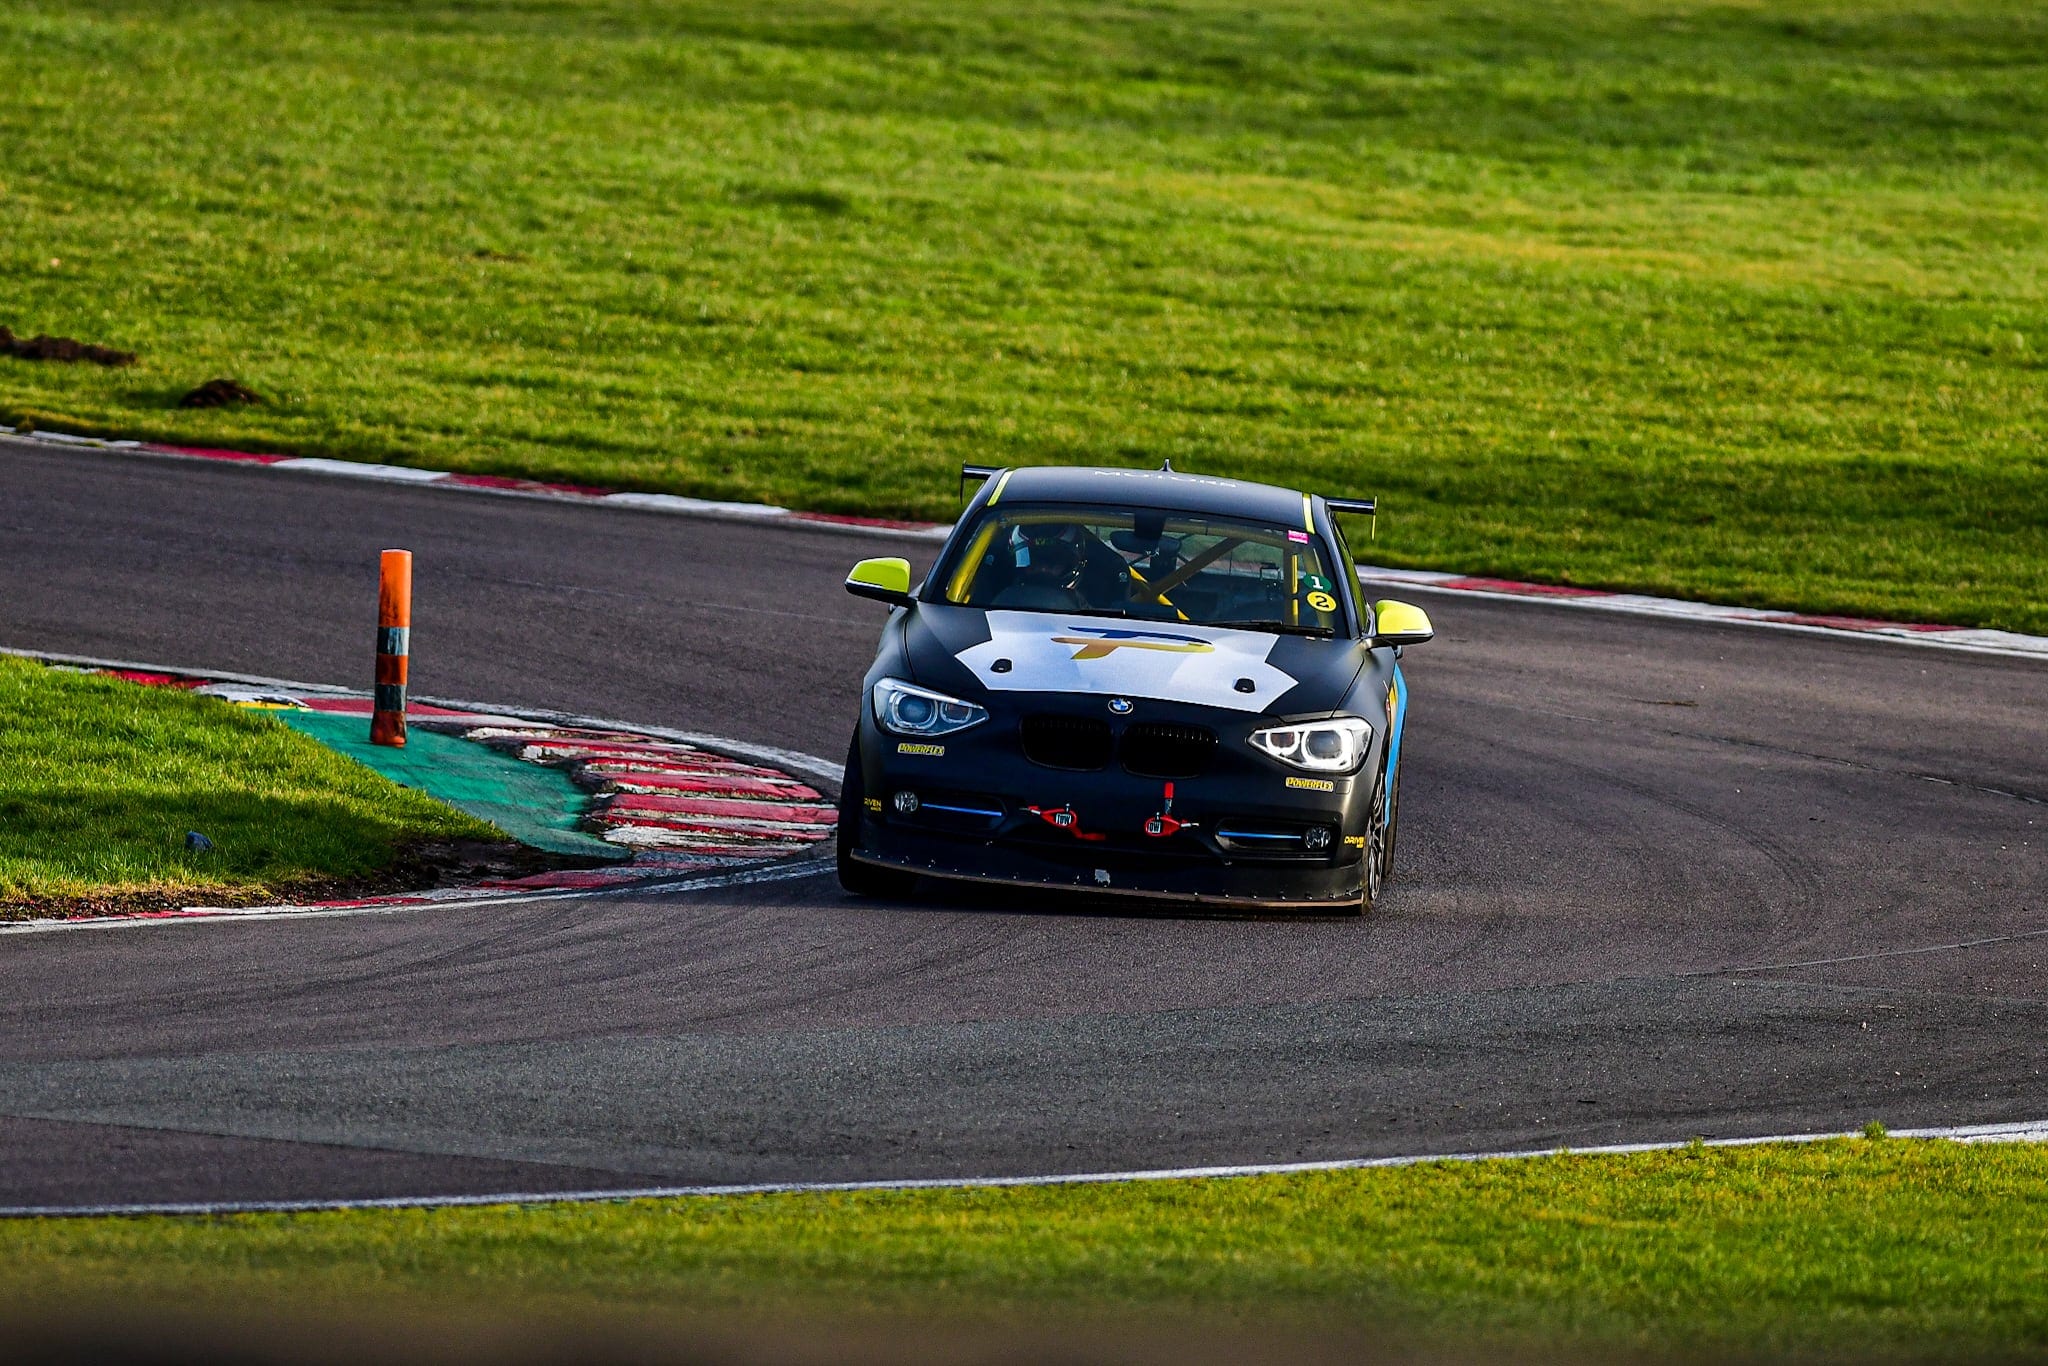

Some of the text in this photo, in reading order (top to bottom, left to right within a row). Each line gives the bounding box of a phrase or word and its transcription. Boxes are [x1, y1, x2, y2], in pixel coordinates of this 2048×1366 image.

[1311, 575, 1324, 590] 1
[1315, 595, 1330, 608] 2
[899, 743, 944, 755] POWERFLEX
[1287, 778, 1333, 791] POWERFLEX
